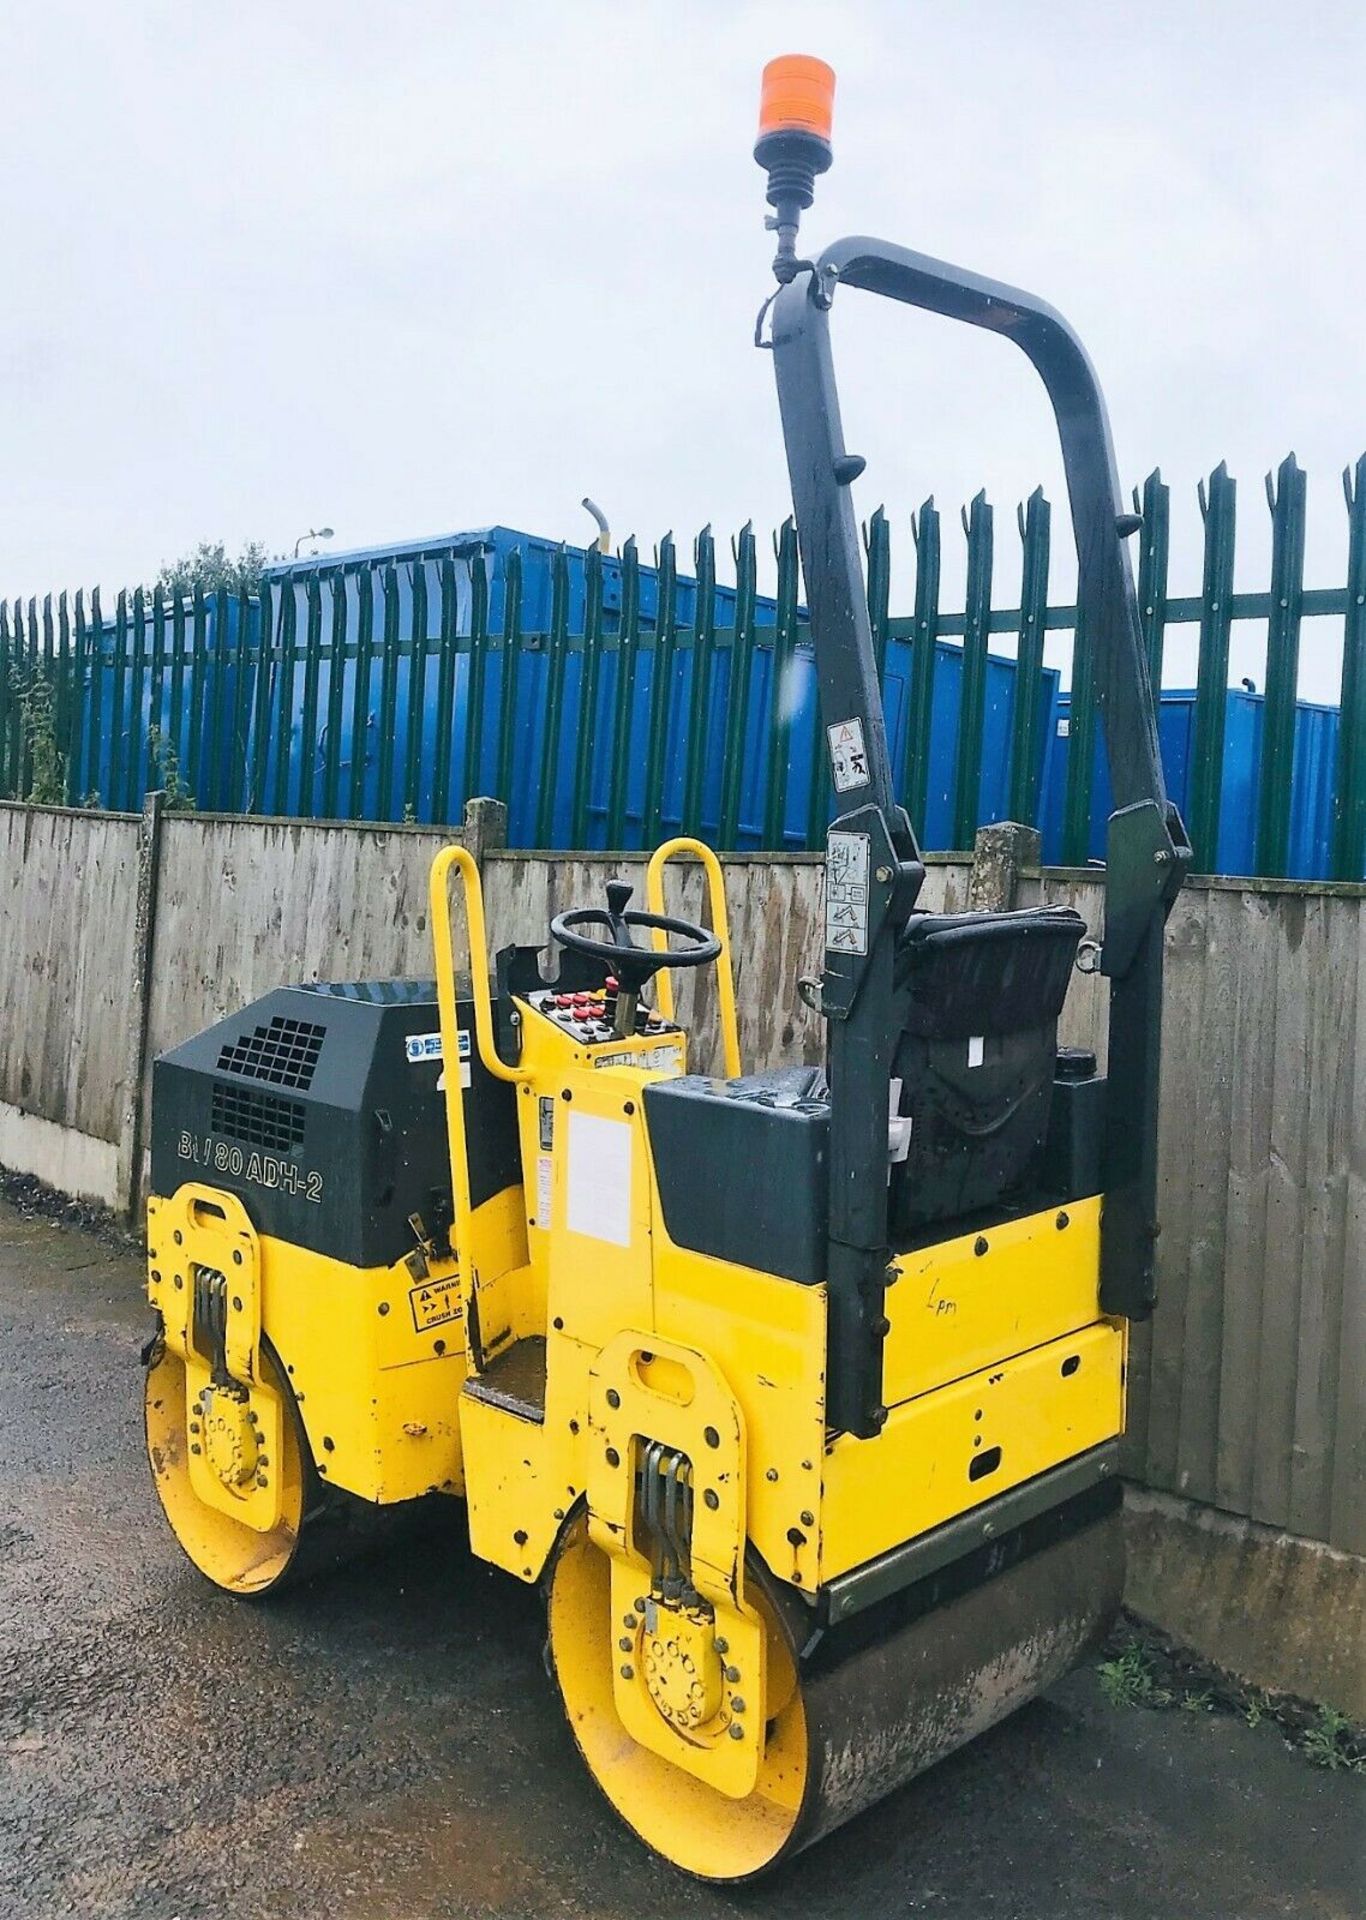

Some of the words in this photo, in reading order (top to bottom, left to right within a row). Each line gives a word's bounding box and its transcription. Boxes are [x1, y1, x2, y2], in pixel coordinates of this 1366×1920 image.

[214, 1142, 244, 1176] 80
[245, 1152, 323, 1203] ADH-2
[426, 1310, 451, 1324] CRUSH
